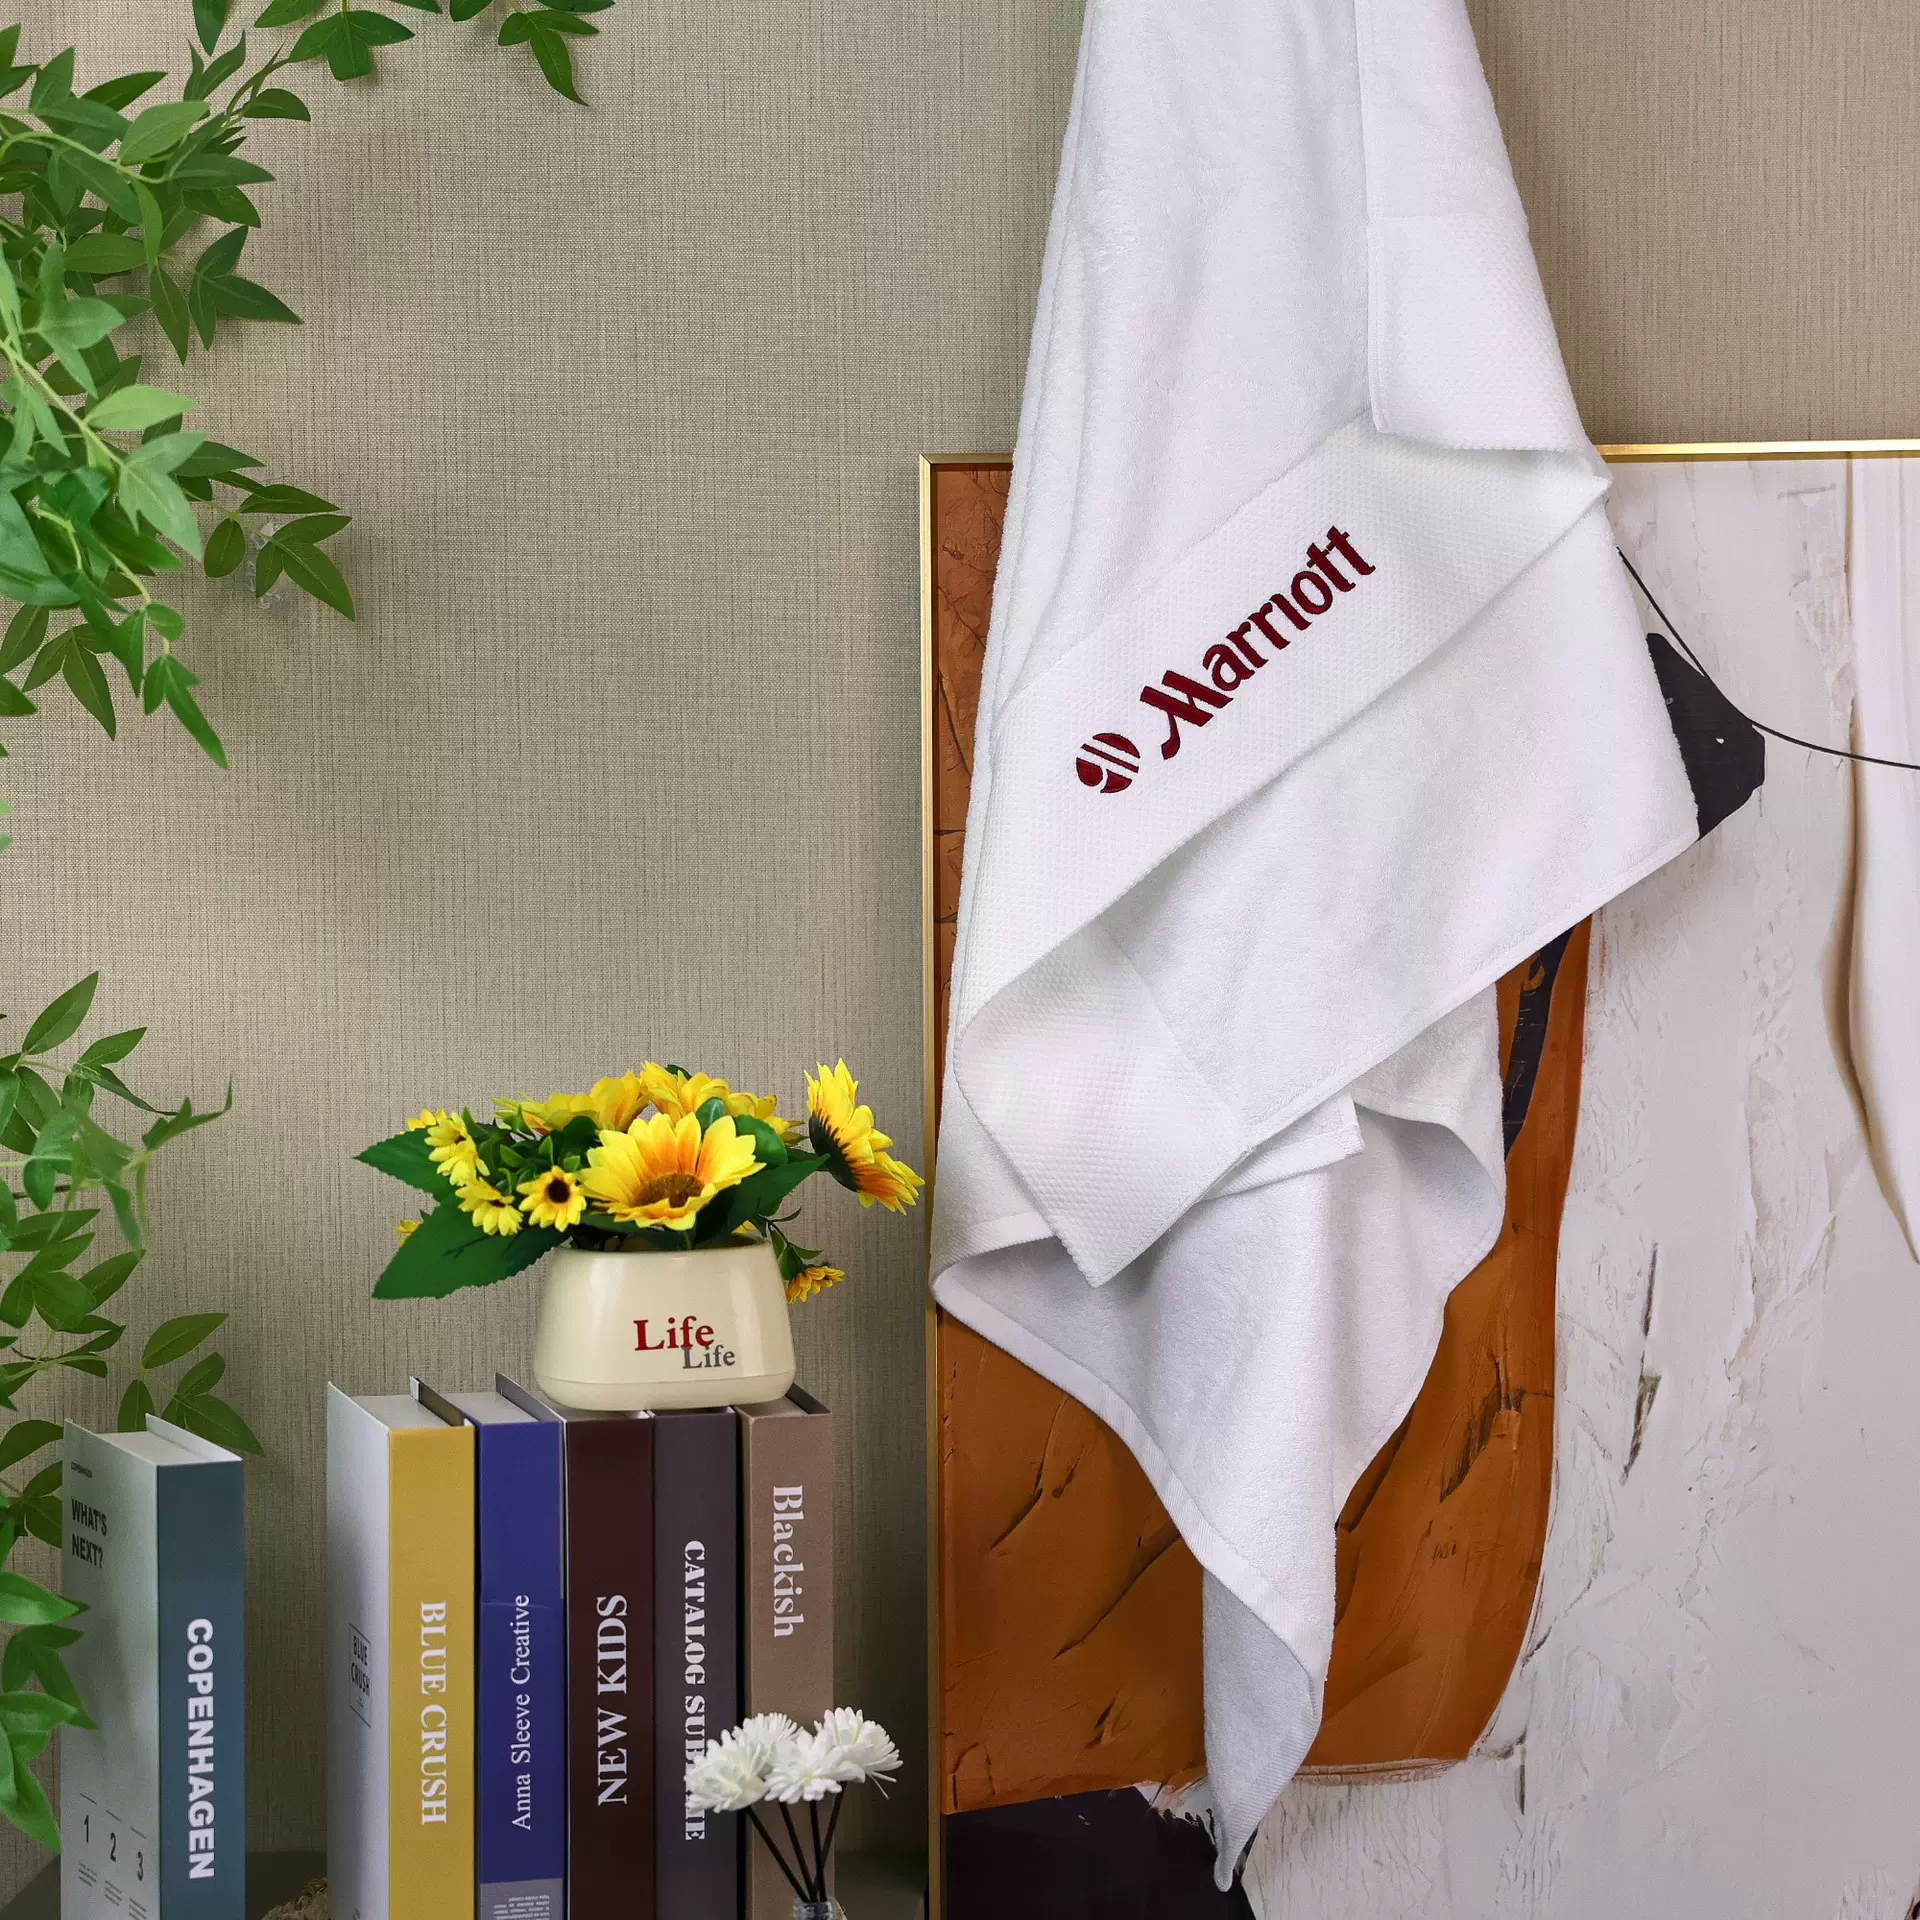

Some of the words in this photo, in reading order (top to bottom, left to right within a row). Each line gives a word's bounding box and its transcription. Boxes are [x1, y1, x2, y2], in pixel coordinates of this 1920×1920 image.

[1140, 525, 1376, 760] Marriott
[633, 1315, 715, 1351] Life
[681, 1344, 736, 1369] Life
[71, 1498, 107, 1537] WHAT'S
[72, 1533, 104, 1569] NEXT?
[772, 1485, 804, 1638] Blackish
[420, 1601, 447, 1695] BLUE
[510, 1594, 531, 1685] Creative
[596, 1595, 628, 1695] KIDS
[684, 1540, 706, 1685] CATALOG
[186, 1617, 215, 1879] COPENHAGEN
[420, 1704, 447, 1825] CRUSH
[511, 1692, 531, 1764] Sleeve
[597, 1707, 628, 1806] NEW
[684, 1695, 706, 1841] SUBE
[84, 1815, 90, 1843] 1
[110, 1832, 117, 1862] 2
[511, 1773, 531, 1831] Anna
[136, 1851, 144, 1881] 3
